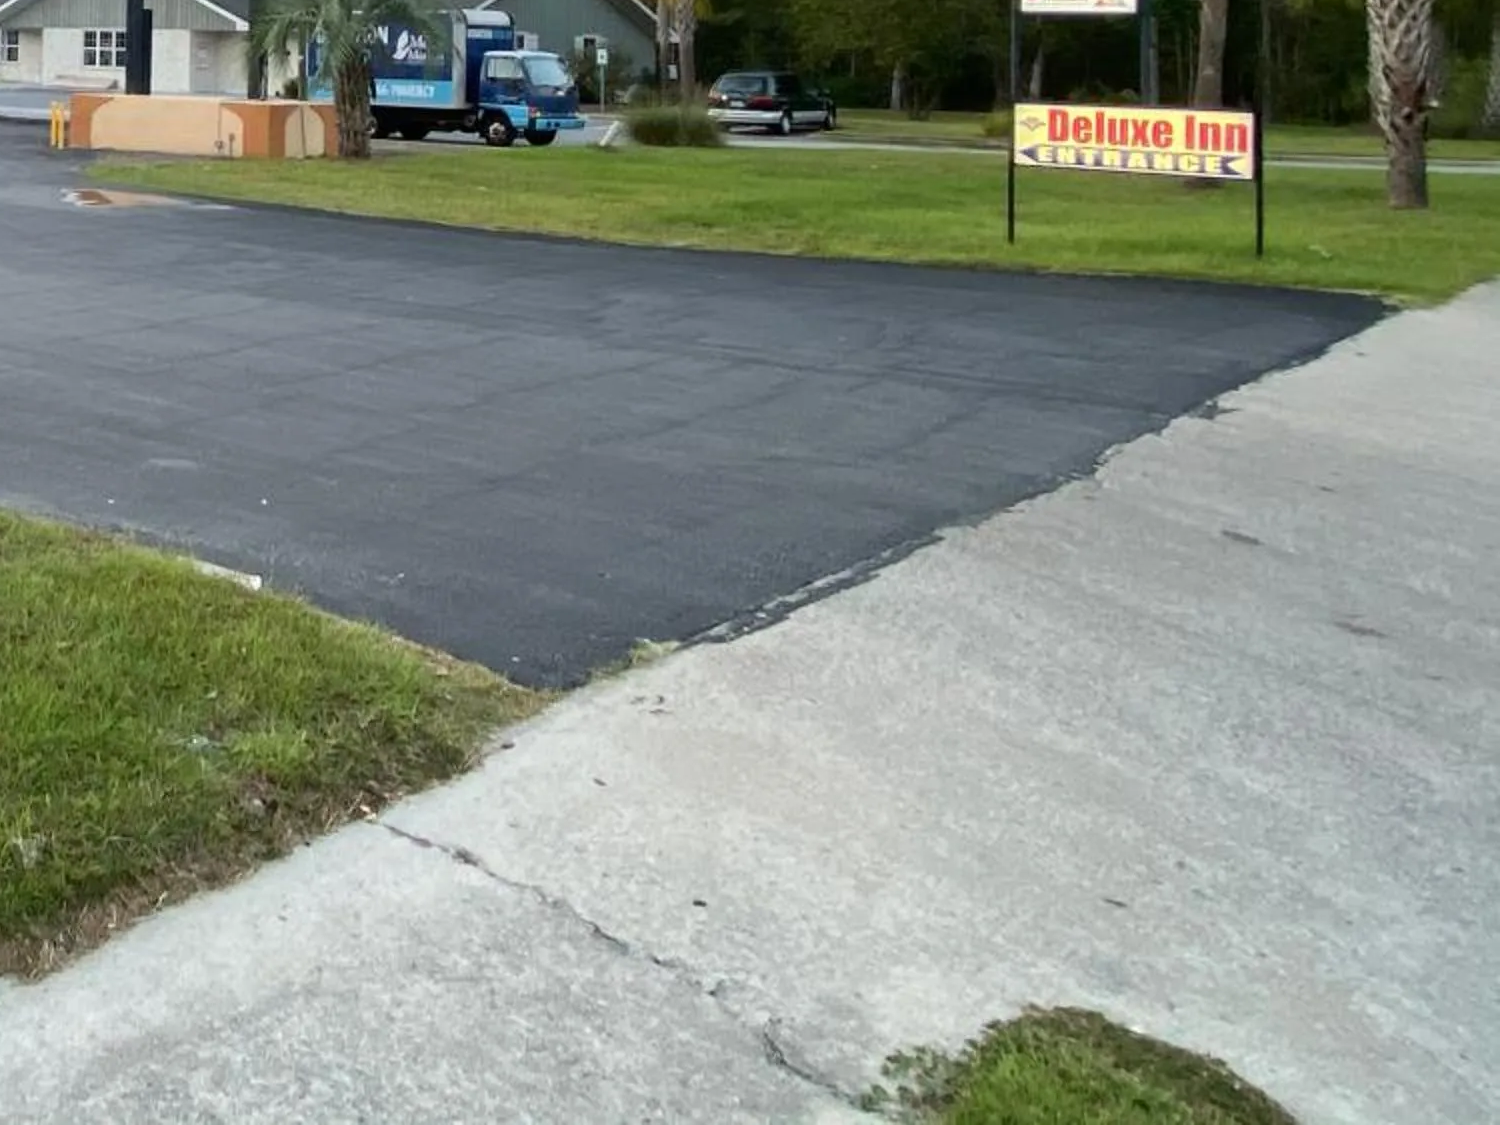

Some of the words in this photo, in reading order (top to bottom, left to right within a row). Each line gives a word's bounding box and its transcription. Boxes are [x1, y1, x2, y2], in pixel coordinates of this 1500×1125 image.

[1048, 108, 1173, 149] Deluxe
[1185, 114, 1249, 153] Inn
[1036, 146, 1223, 173] ENTRANCE
